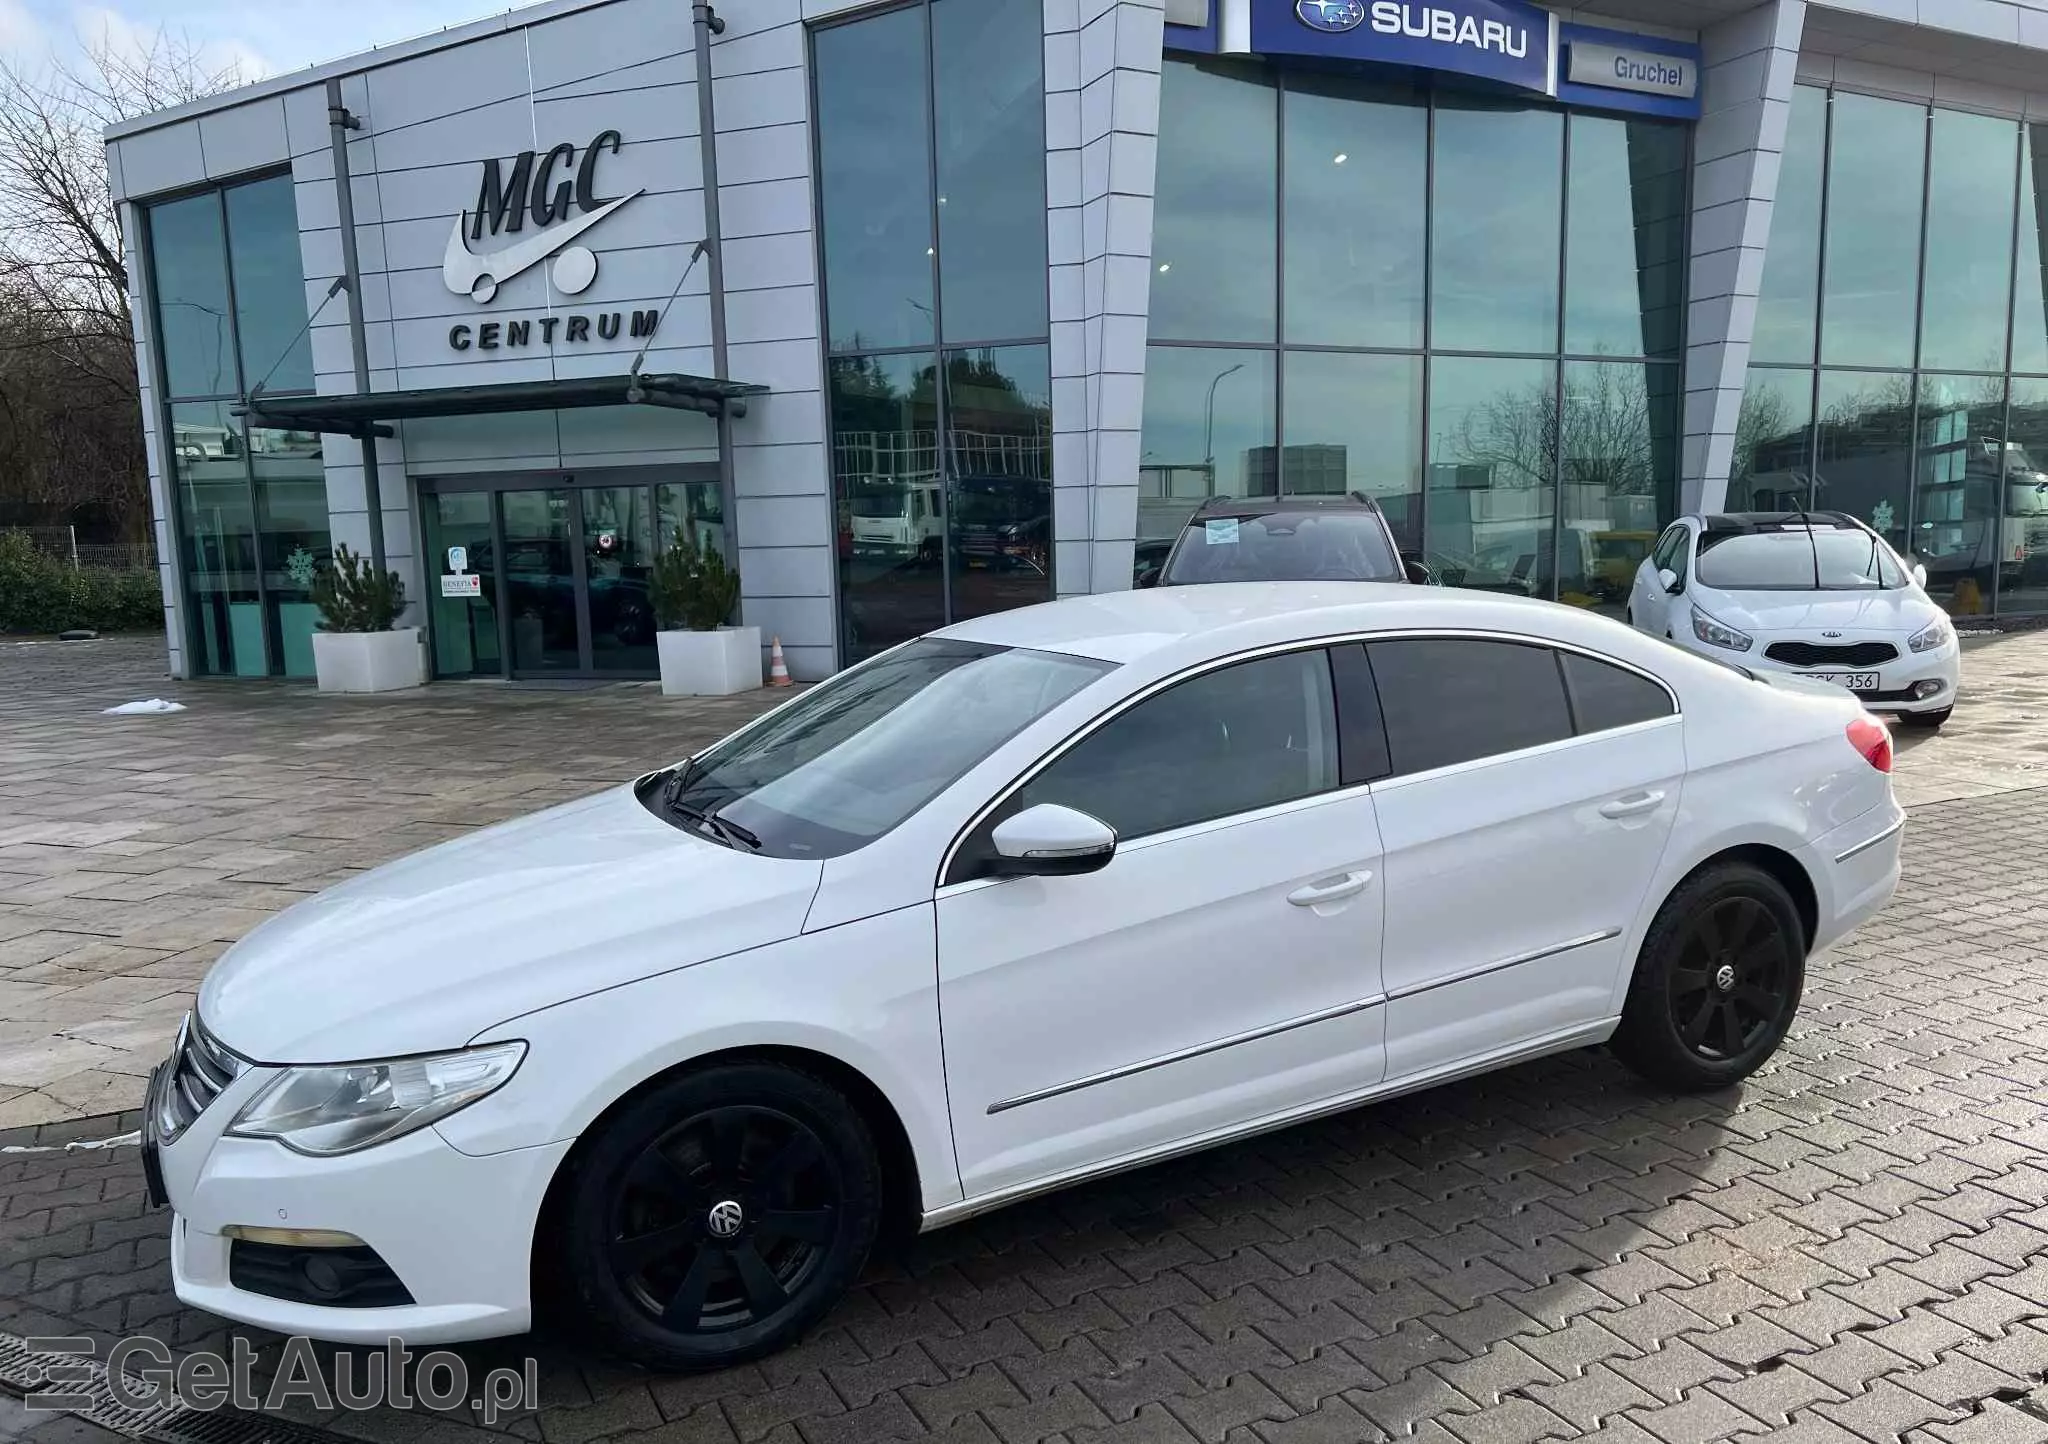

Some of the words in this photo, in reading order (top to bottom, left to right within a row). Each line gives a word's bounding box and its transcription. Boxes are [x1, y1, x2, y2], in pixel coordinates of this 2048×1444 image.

[1371, 1, 1527, 58] SUBARU
[1614, 56, 1682, 86] Gruchel
[471, 129, 624, 239] MGC
[449, 310, 658, 350] CENTRUM
[1845, 674, 1873, 688] 356
